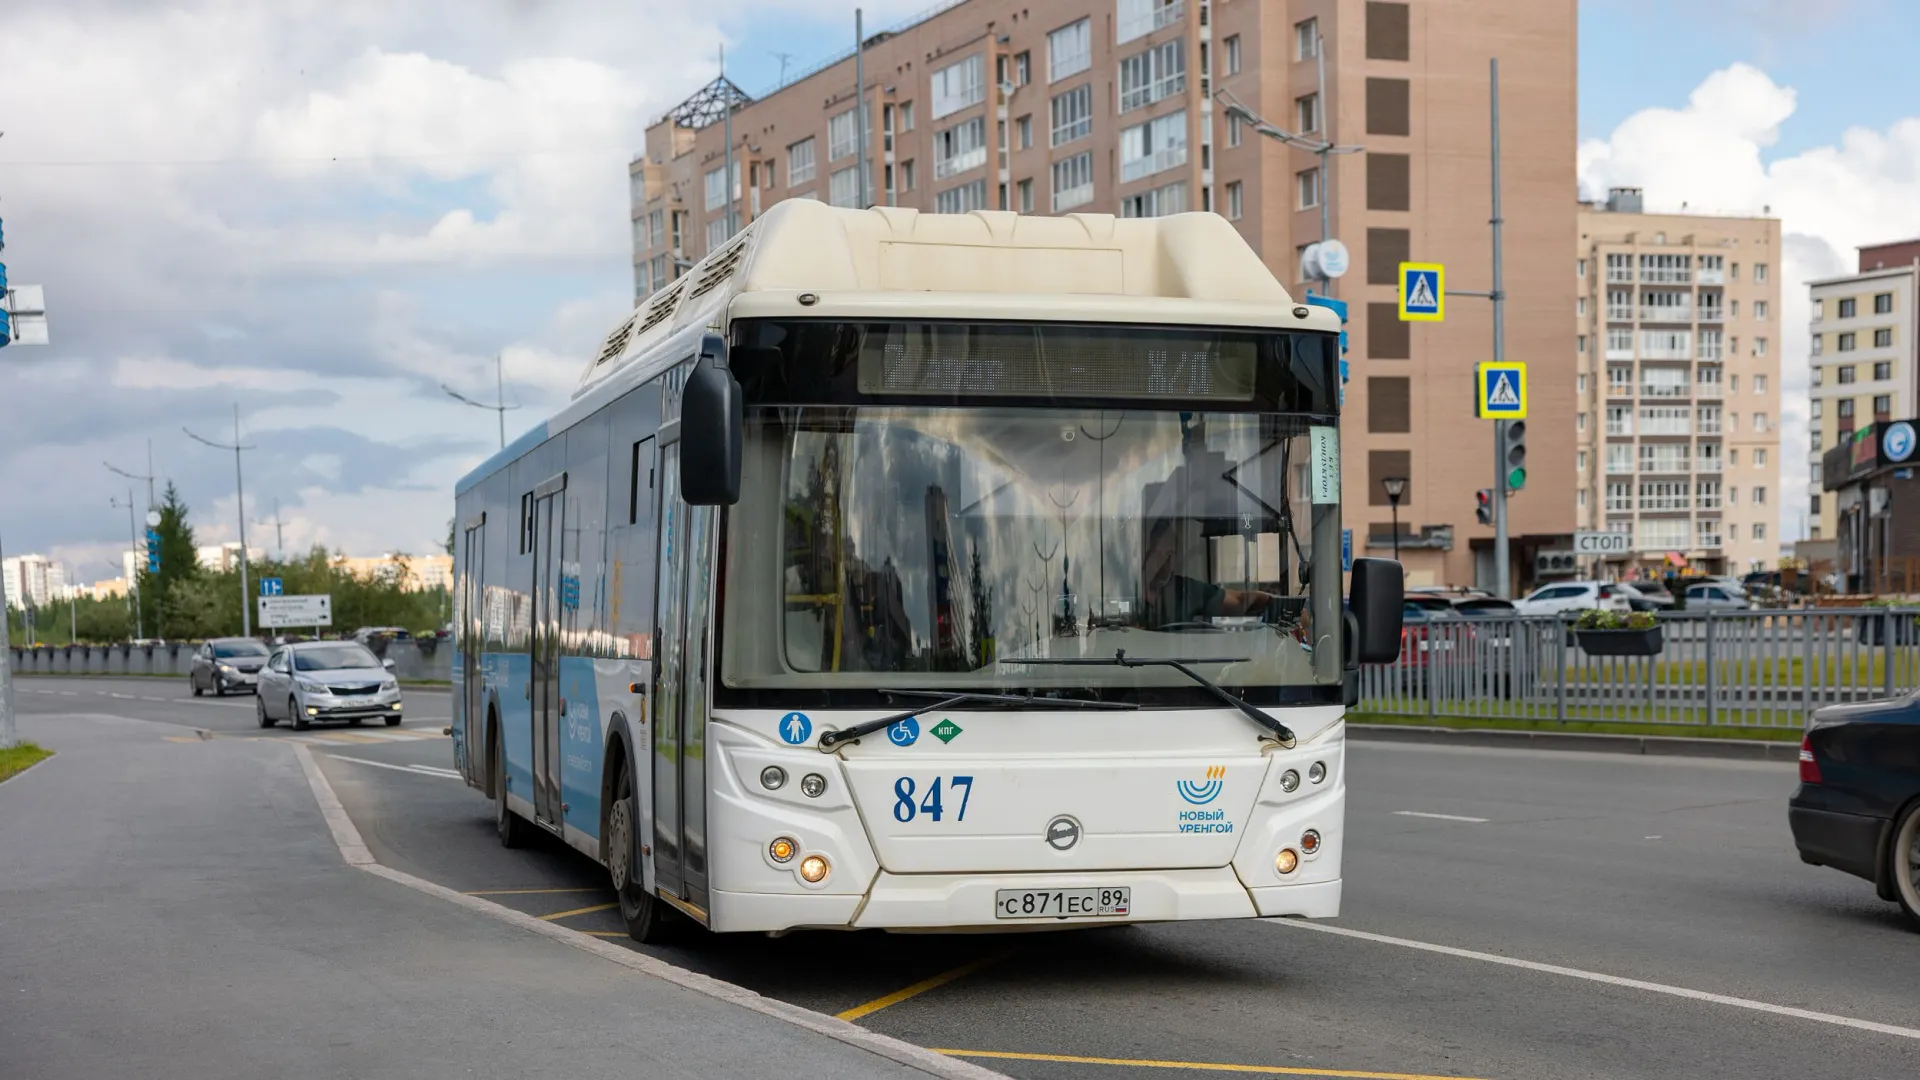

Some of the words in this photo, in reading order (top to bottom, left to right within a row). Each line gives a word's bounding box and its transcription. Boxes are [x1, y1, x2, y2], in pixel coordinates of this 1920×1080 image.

[1581, 536, 1623, 550] СТОП
[938, 726, 954, 735] КПГ
[893, 776, 974, 823] 847
[1179, 808, 1224, 821] НОВЫЙ
[1178, 821, 1233, 834] УРЕНГОЙ
[1005, 892, 1094, 915] С871ЕС
[1101, 890, 1123, 906] 89
